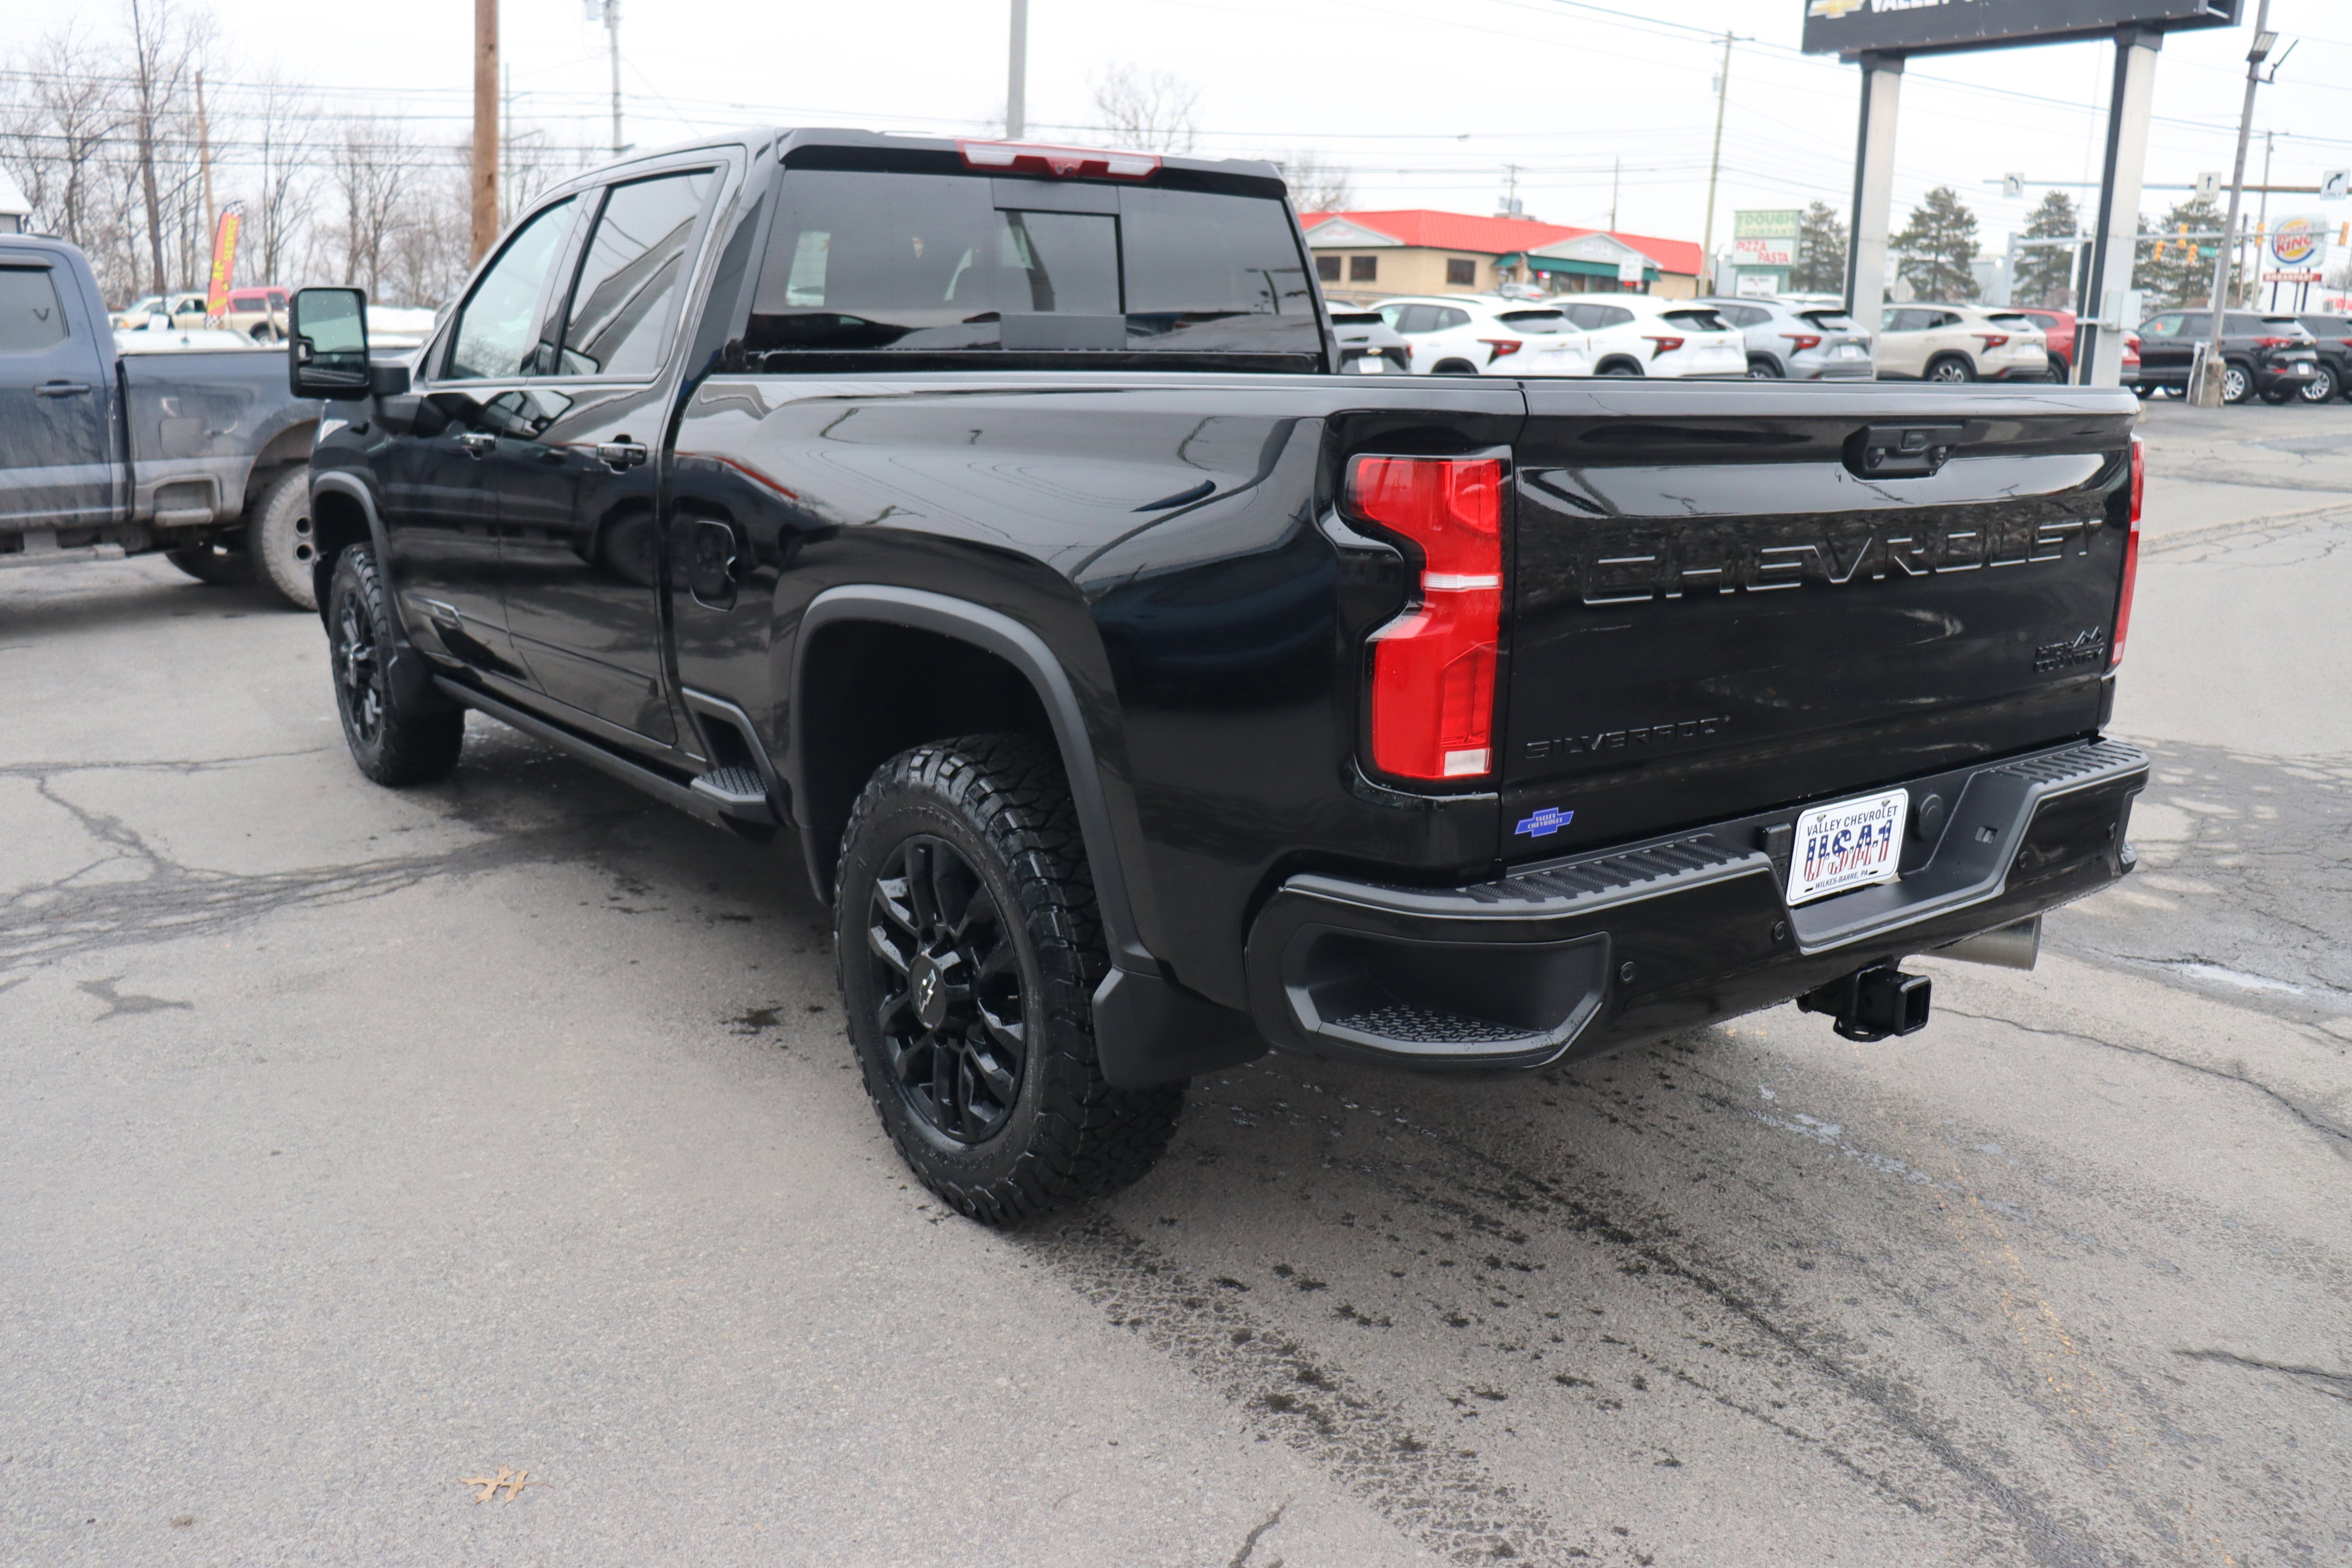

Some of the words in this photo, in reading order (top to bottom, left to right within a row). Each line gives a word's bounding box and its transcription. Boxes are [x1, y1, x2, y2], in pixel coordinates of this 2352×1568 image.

[1737, 240, 1766, 252] PIZZA
[1758, 252, 1788, 263] PASTA
[1583, 518, 2103, 605] CHEVROLET
[2035, 640, 2075, 660] HIGH
[2033, 647, 2103, 673] COUNTRY
[1525, 717, 1719, 759] SILVERADO
[1527, 817, 1563, 829] CHEVROLET
[1535, 813, 1556, 822] VALLEY
[1807, 818, 1842, 837] VALLEY
[1844, 805, 1898, 828] CHEVROLET
[1814, 871, 1859, 889] WILKES-BARRE,
